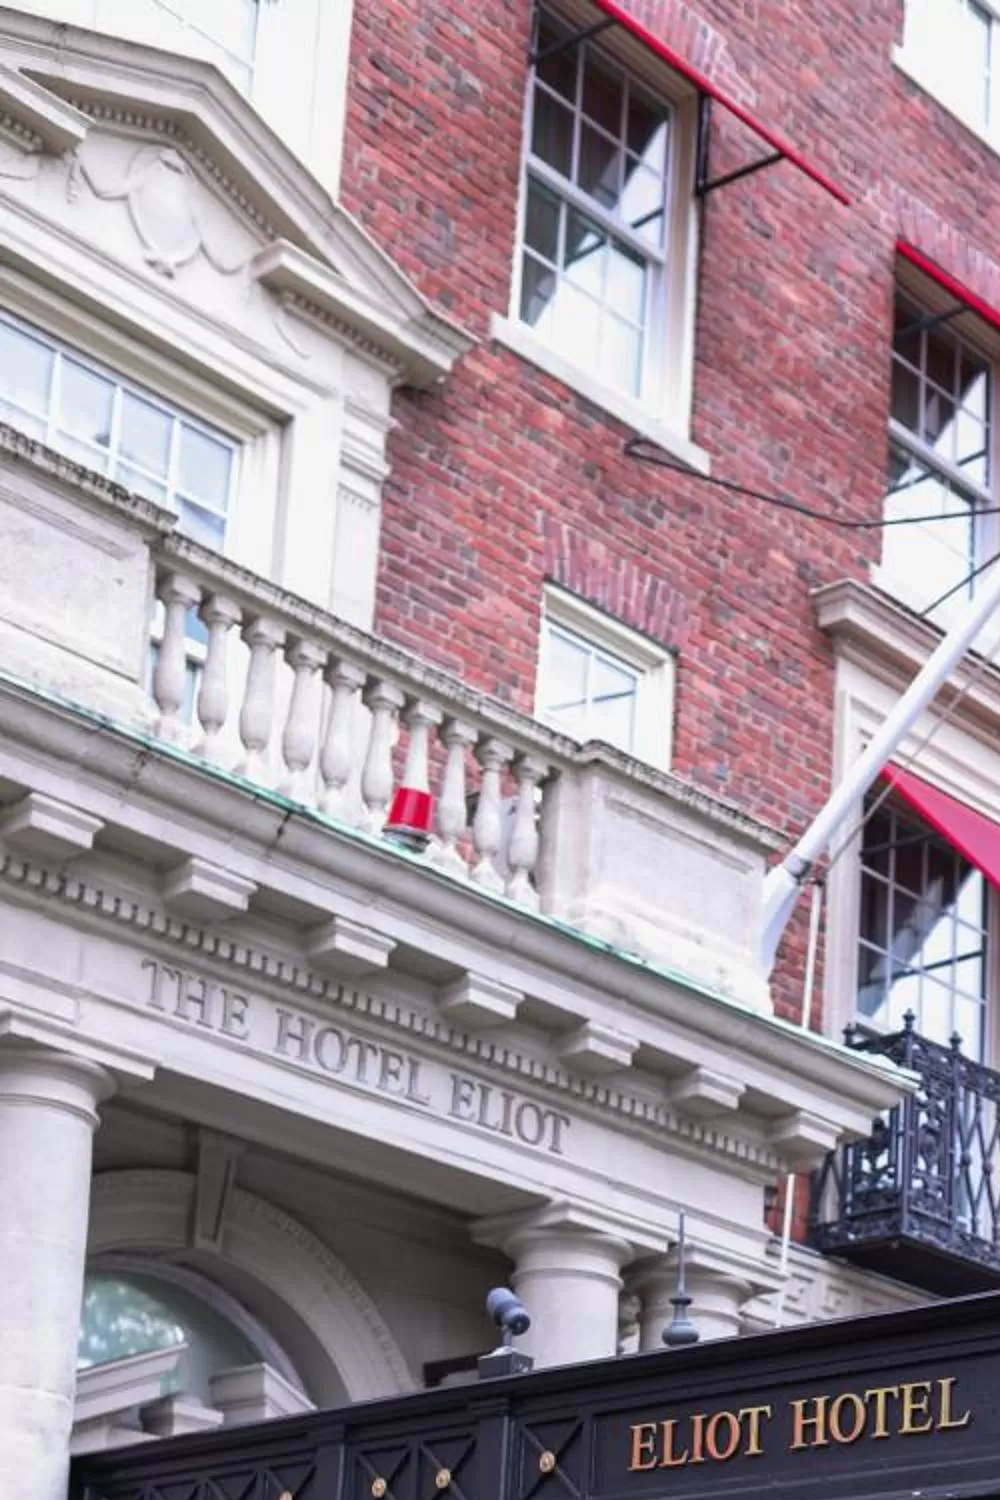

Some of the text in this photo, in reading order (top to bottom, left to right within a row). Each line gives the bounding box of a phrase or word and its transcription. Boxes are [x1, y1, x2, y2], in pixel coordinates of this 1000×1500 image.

[141, 958, 570, 1154] THE HOTEL ELIOT
[628, 1377, 972, 1471] ELIOT HOTEL
